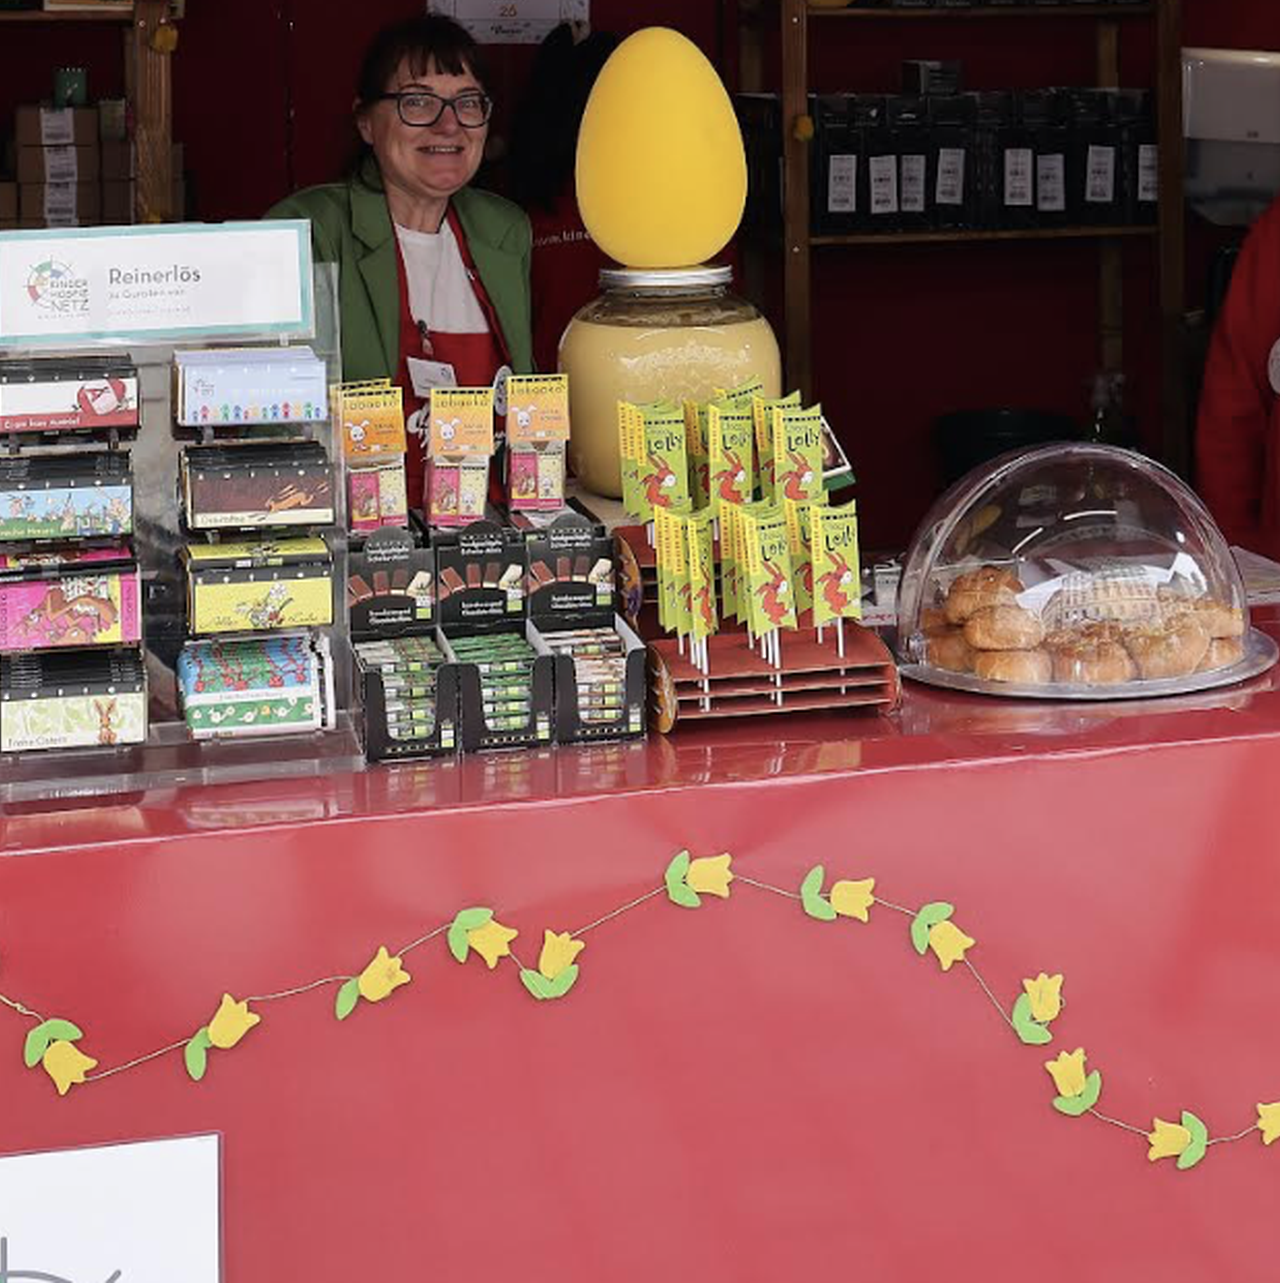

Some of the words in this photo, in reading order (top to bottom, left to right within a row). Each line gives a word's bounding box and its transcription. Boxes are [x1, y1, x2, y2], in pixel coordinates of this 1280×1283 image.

[108, 264, 201, 286] Reinerlös
[50, 299, 90, 314] NETZ
[647, 433, 683, 455] Lolly
[787, 428, 820, 452] Lolly
